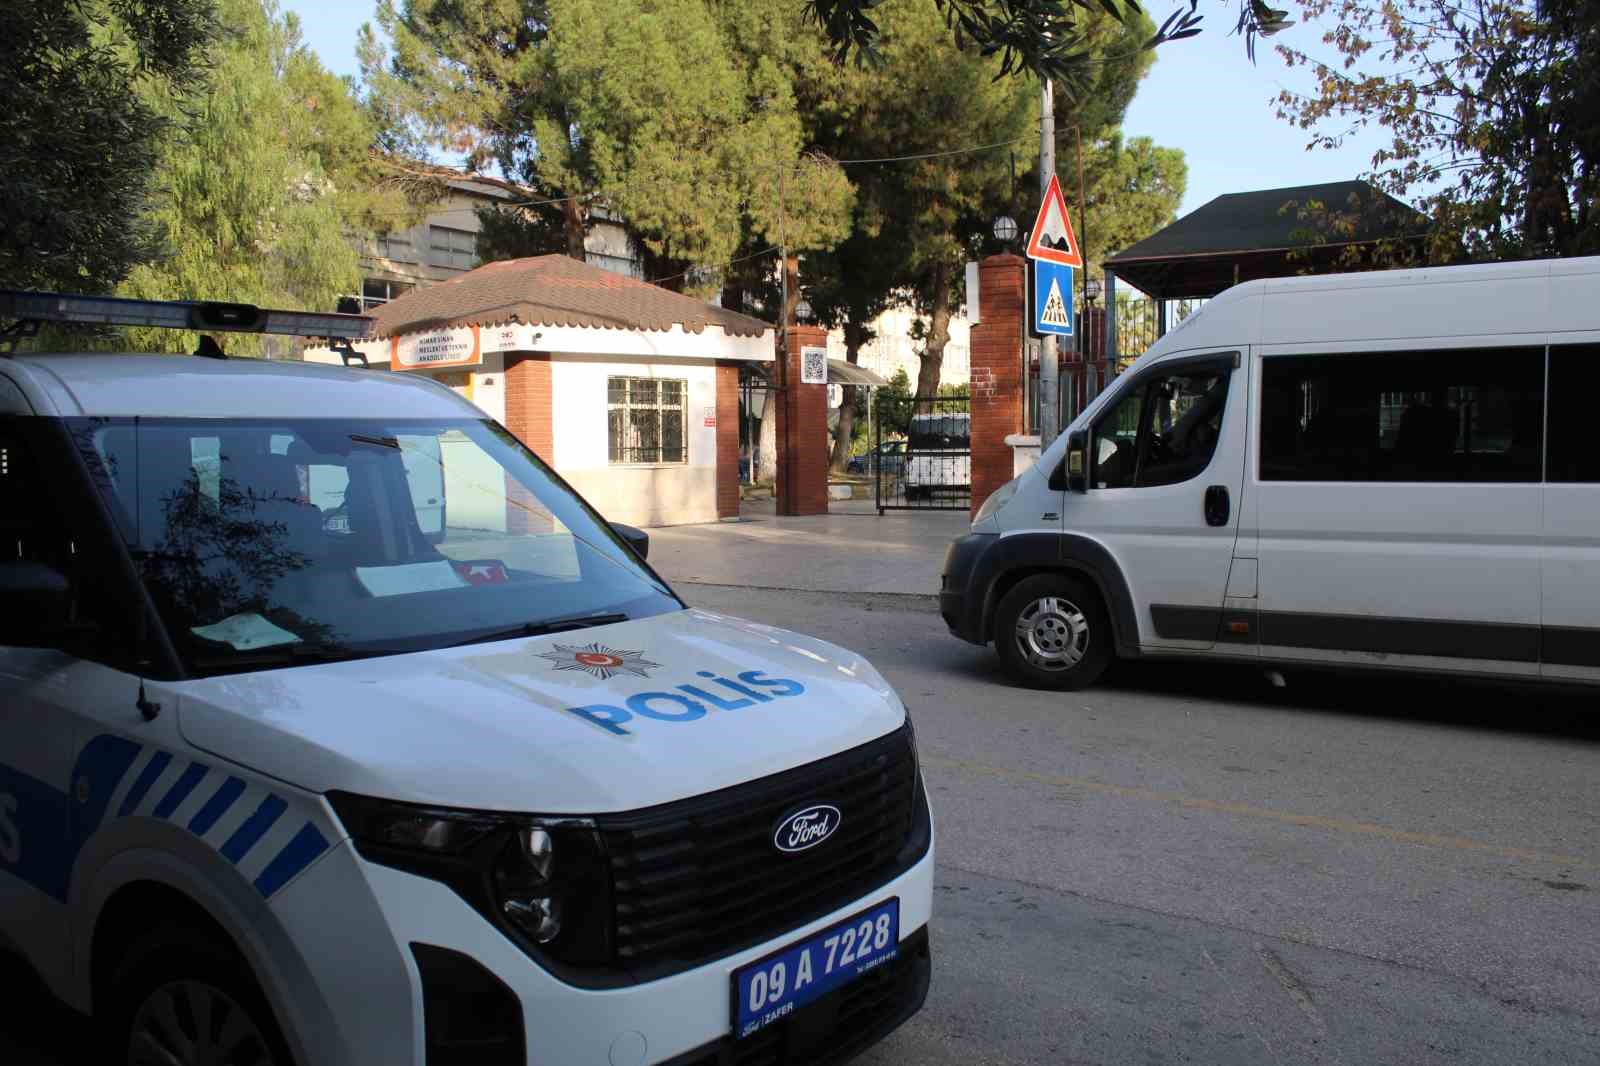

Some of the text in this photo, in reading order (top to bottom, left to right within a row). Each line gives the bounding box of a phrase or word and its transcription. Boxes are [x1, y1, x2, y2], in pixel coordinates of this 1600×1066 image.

[565, 670, 805, 735] POLİS
[788, 812, 829, 847] Ford
[750, 963, 786, 1012] 09
[794, 949, 813, 991] A
[823, 913, 890, 975] 7228
